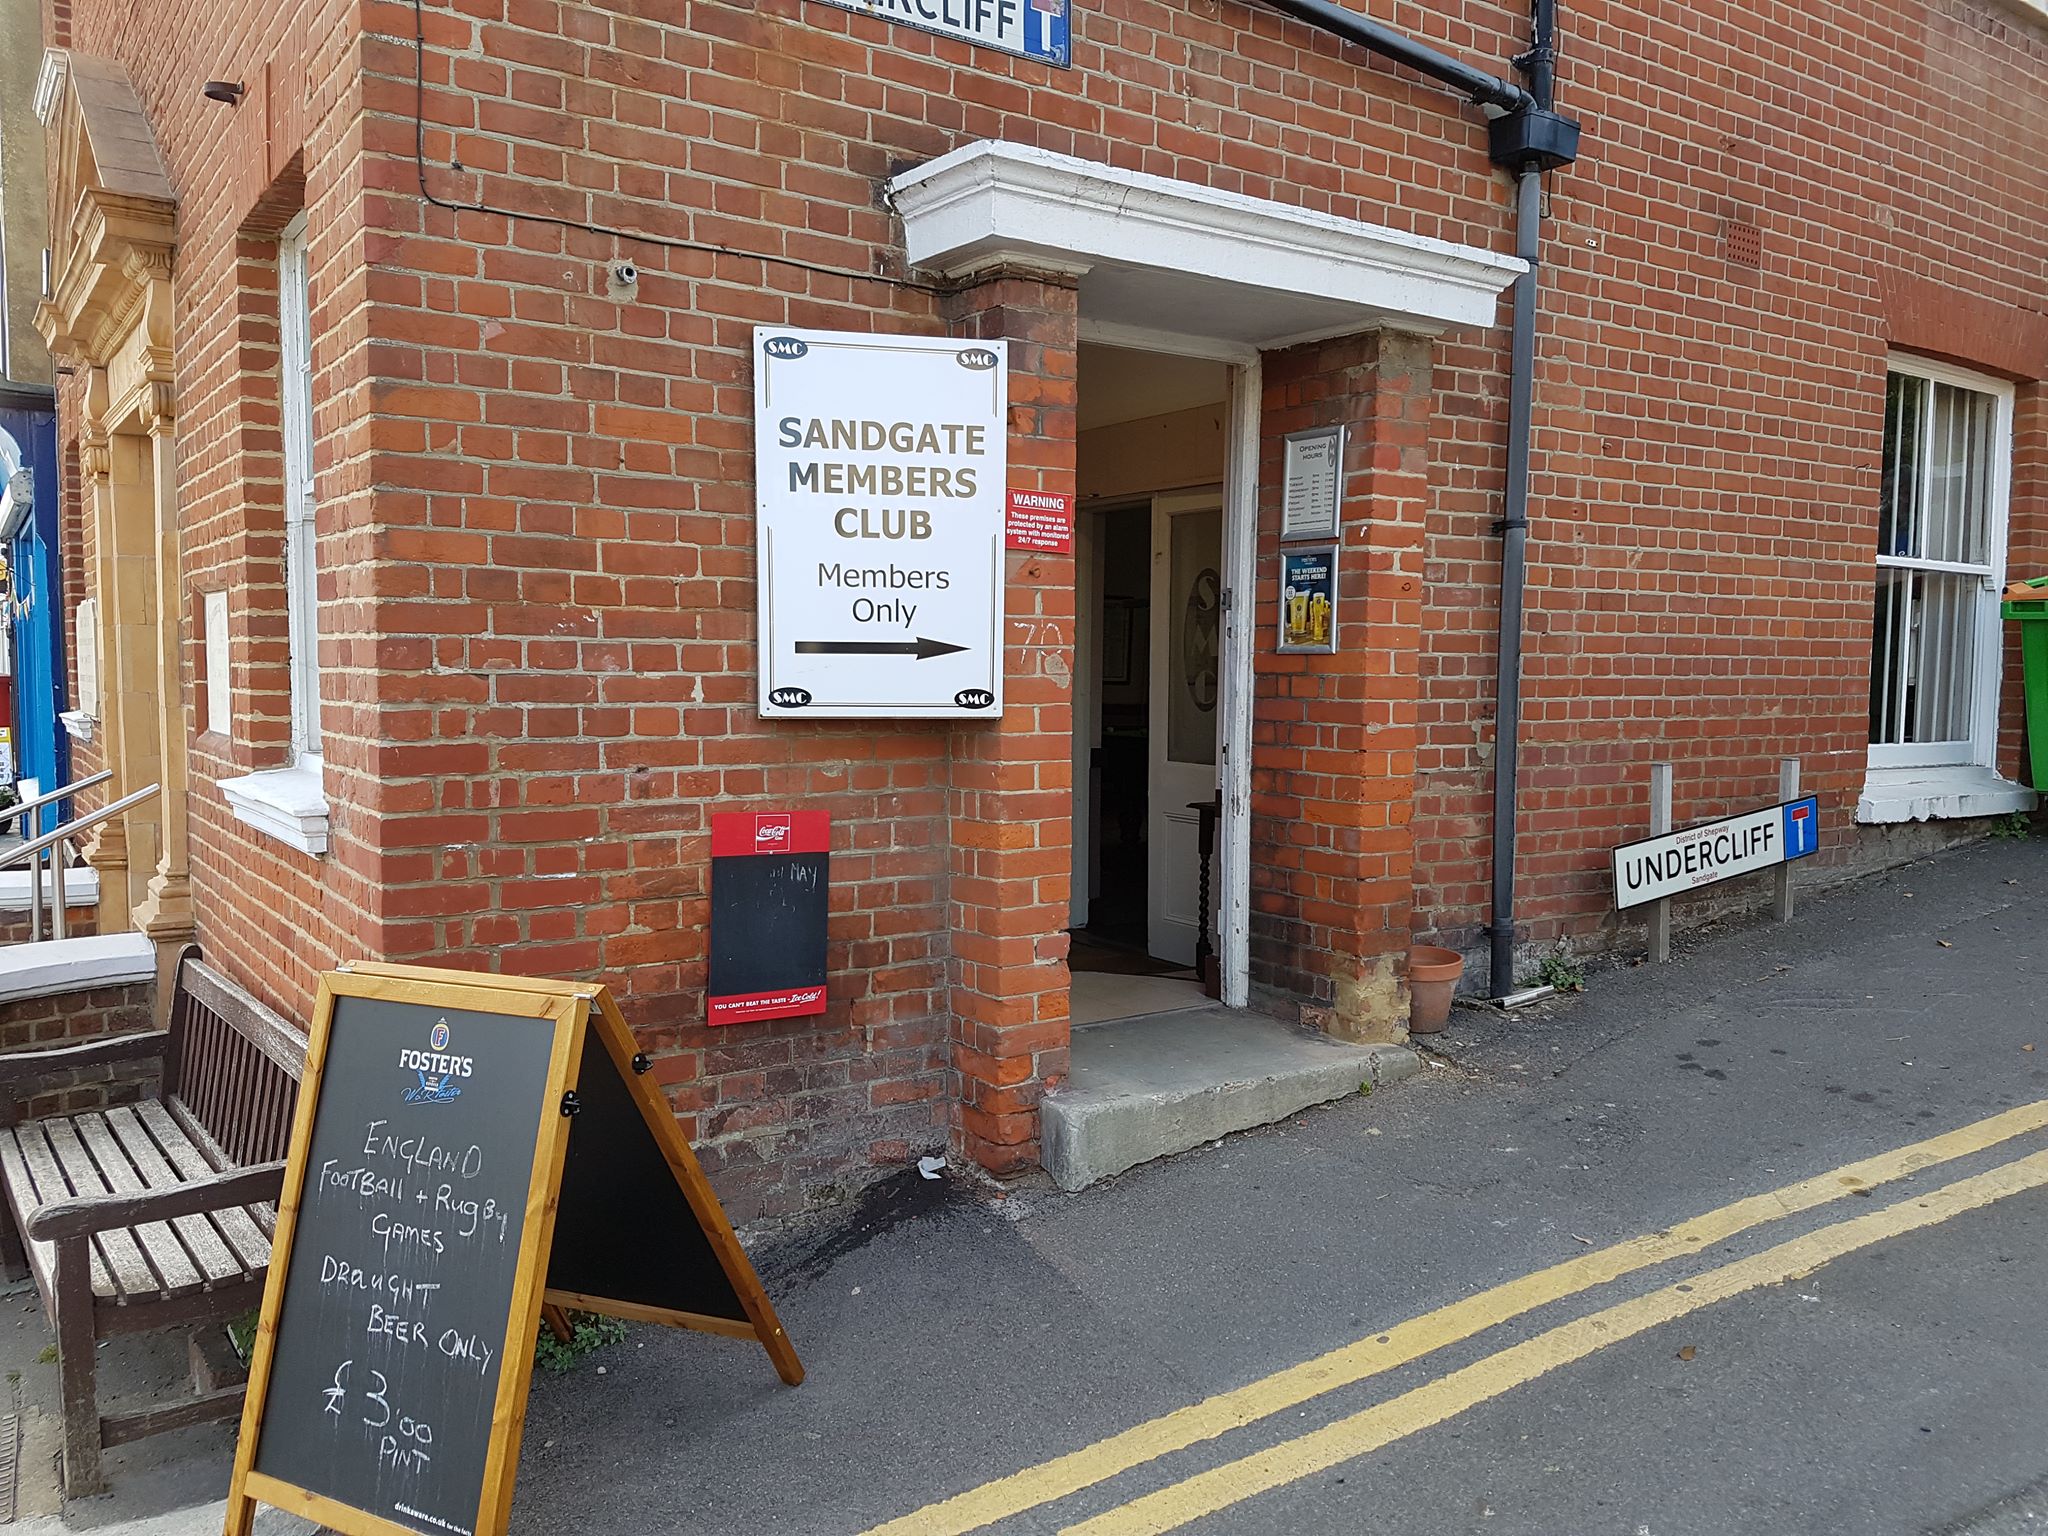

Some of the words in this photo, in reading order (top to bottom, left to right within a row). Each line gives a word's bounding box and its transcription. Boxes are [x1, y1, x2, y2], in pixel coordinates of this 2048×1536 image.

[768, 341, 803, 356] SMC
[960, 352, 994, 366] SMC
[779, 416, 985, 455] SANDGATE
[788, 461, 978, 499] MEMBERS
[1013, 493, 1064, 509] WARNING
[834, 507, 933, 540] CLUB
[1007, 520, 1035, 528] protected
[1036, 522, 1043, 531] by
[1011, 511, 1028, 519] These
[1029, 514, 1055, 522] premises
[1032, 538, 1058, 546] response
[1041, 531, 1069, 539] monitored
[818, 562, 950, 590] Members
[1301, 566, 1328, 574] WEEKEND
[852, 597, 918, 629] Only
[773, 691, 807, 705] SMC
[958, 692, 991, 706] SMC
[1675, 832, 1696, 845] District
[1697, 831, 1704, 840] of
[1704, 824, 1730, 838] Shepway
[1626, 822, 1775, 889] UNDERCLIFF
[1691, 870, 1719, 885] Sandgate
[399, 1049, 473, 1078] FOSTER'S
[364, 1119, 482, 1179] ENGLAND
[372, 1213, 444, 1253] GAMES
[367, 1304, 429, 1348] BEER
[438, 1328, 494, 1375] ONLY
[379, 1435, 431, 1474] PINT
[394, 1502, 446, 1528] drinkaware.co.uk
[446, 1522, 454, 1530] for
